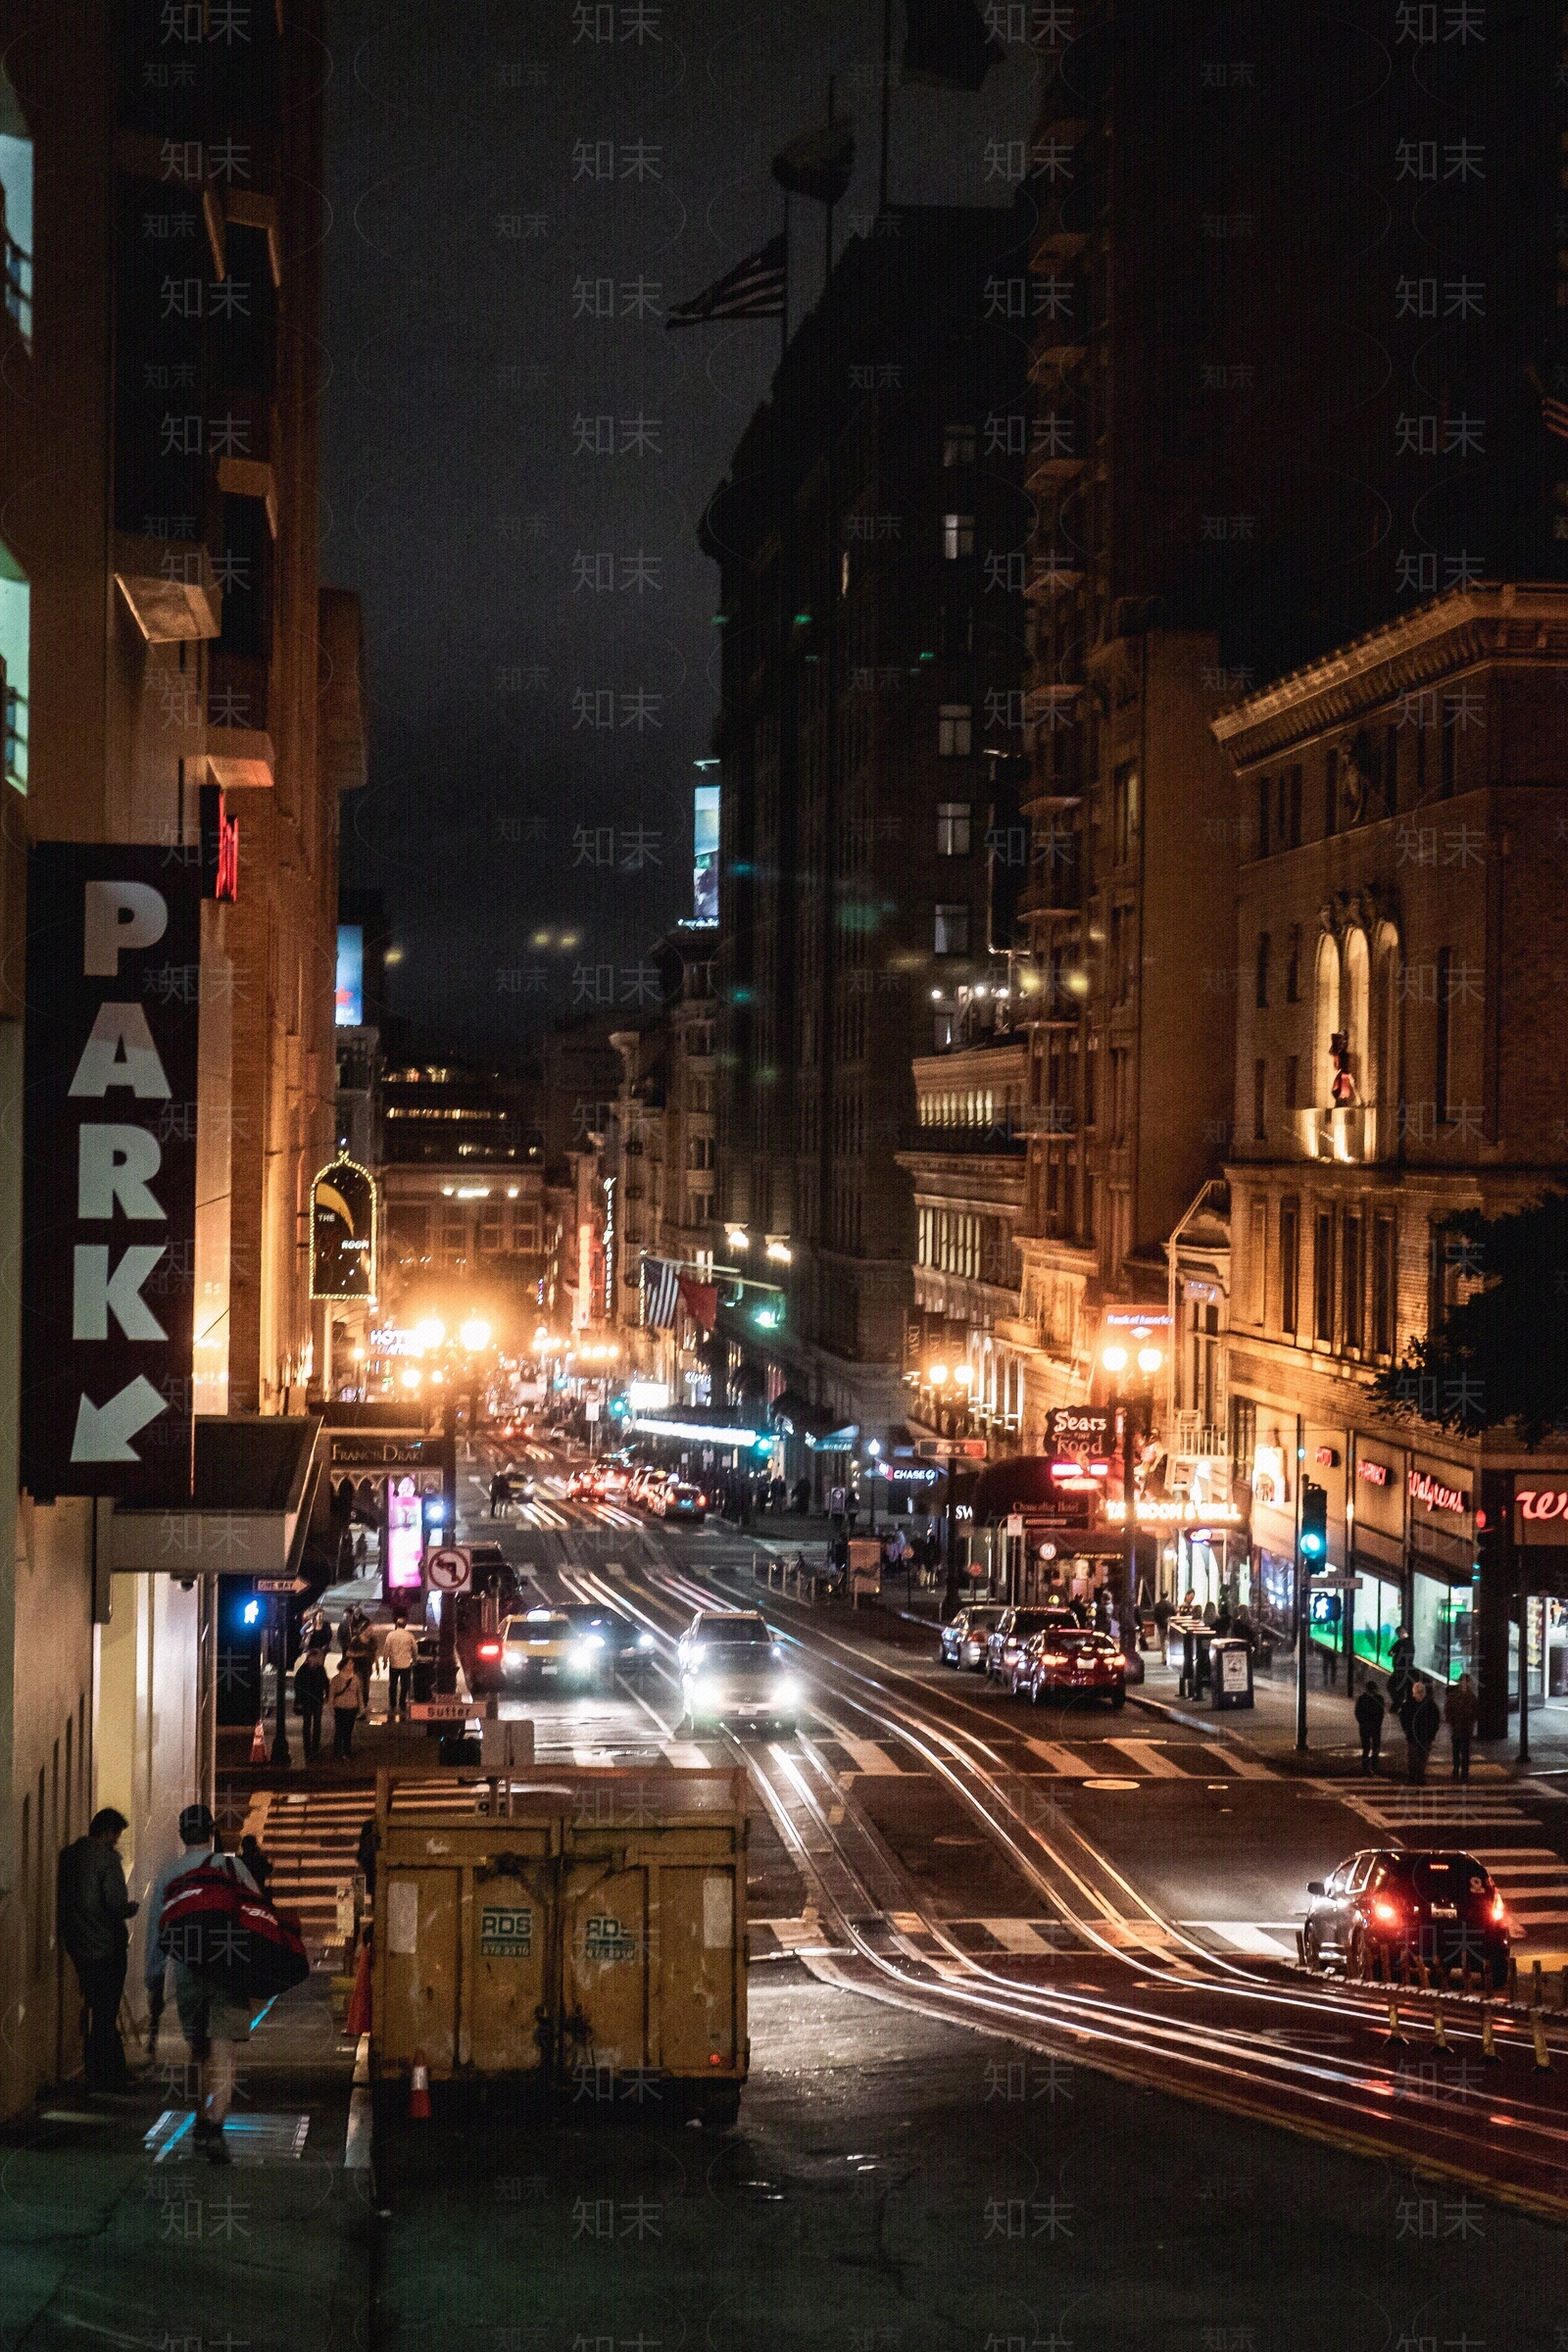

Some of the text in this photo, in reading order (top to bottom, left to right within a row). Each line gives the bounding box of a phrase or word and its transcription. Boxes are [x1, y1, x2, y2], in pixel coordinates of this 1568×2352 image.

[68, 880, 172, 1343] PARK
[318, 1213, 336, 1222] THE
[341, 1240, 369, 1250] ROOM
[1053, 1410, 1107, 1433] Sears
[894, 1469, 925, 1480] CHASE
[1407, 1470, 1464, 1513] Walgreens
[427, 1706, 470, 1718] Sutter
[481, 1915, 531, 1936] RDS
